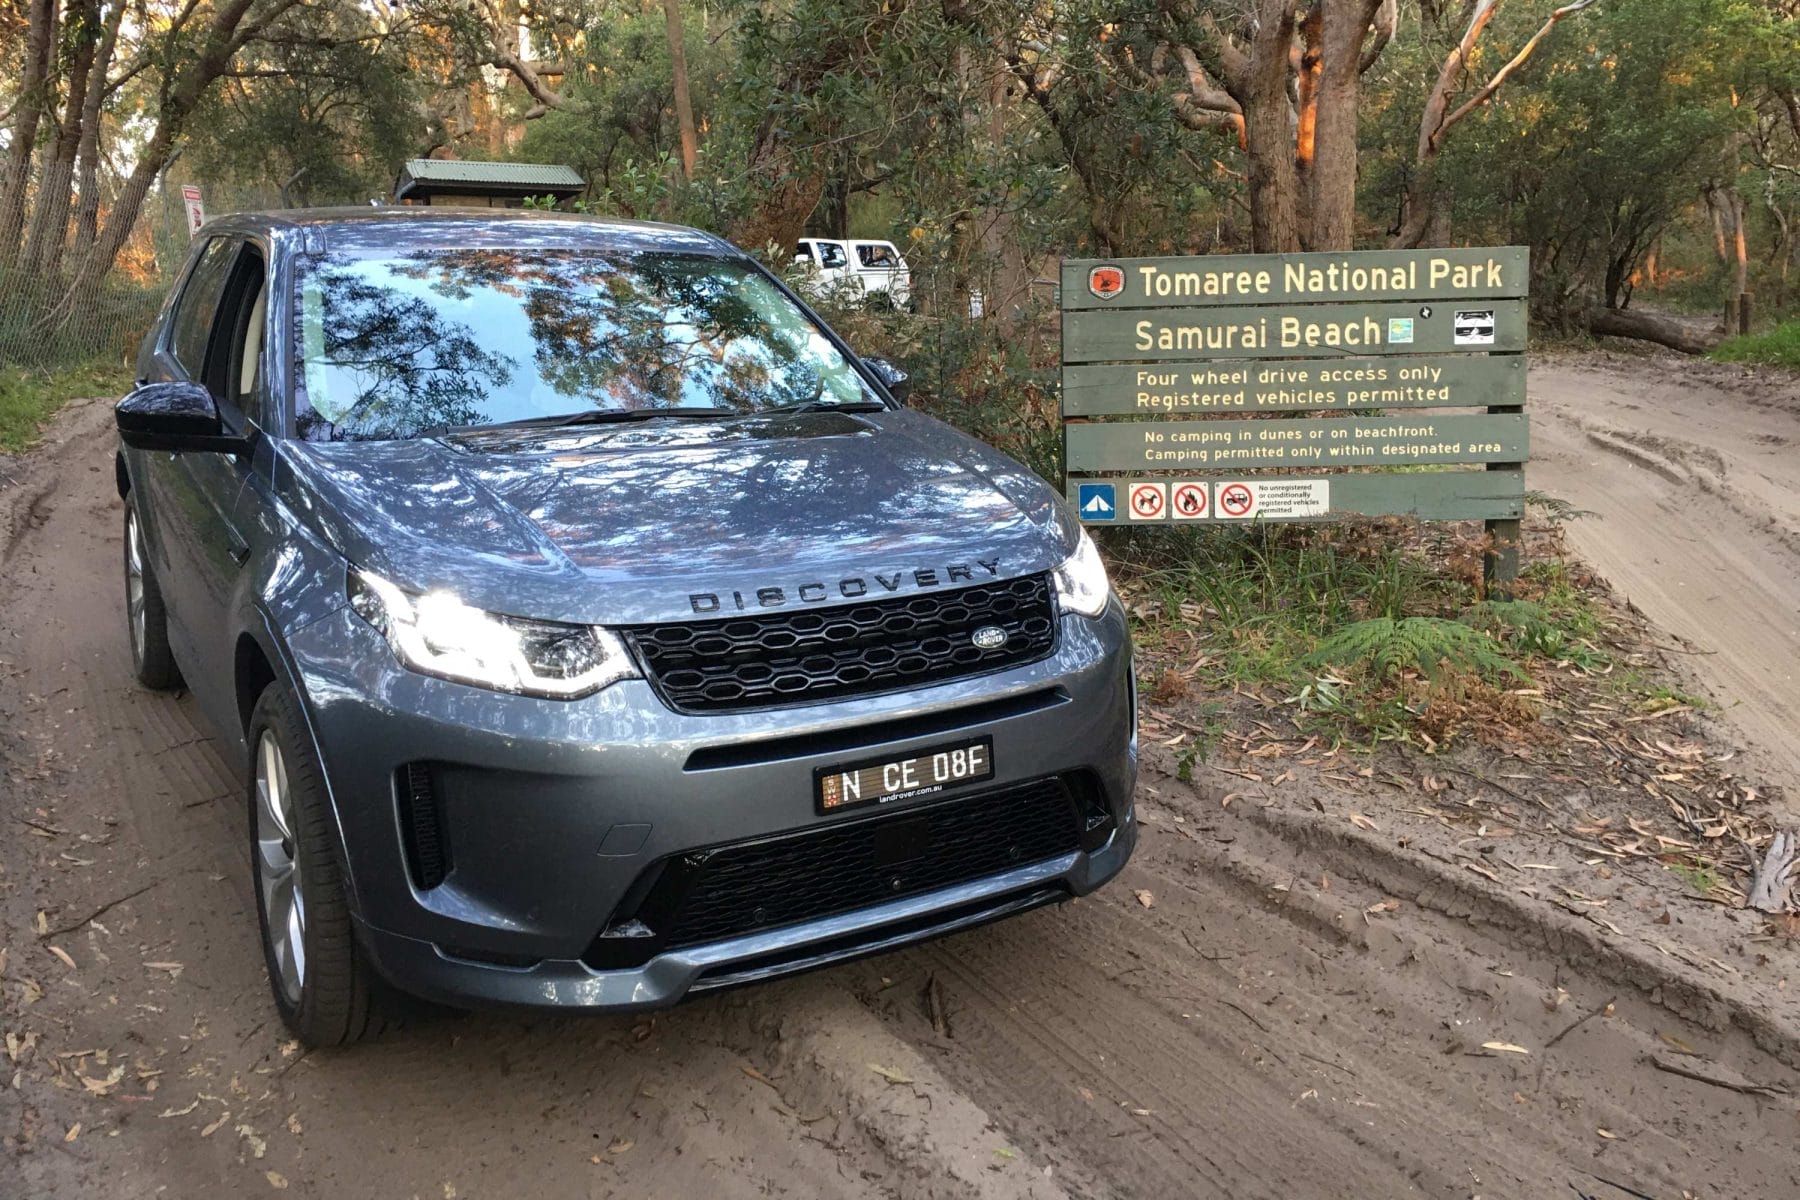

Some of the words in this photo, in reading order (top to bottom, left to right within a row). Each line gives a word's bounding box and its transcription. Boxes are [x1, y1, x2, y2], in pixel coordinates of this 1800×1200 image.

[1138, 266, 1270, 297] Tomaree
[1285, 261, 1416, 293] National
[1430, 259, 1503, 289] Park
[1135, 317, 1267, 352] Samurai
[1281, 316, 1381, 348] Beach
[1136, 371, 1179, 387] Four
[1191, 369, 1248, 385] wheel
[1258, 368, 1309, 384] drive
[1319, 367, 1388, 382] access
[1398, 365, 1442, 383] only
[1136, 390, 1246, 411] Registered
[1256, 388, 1336, 404] vehicles
[1347, 386, 1450, 407] permitted
[1145, 432, 1164, 443] No
[1170, 430, 1232, 445] camping
[1238, 429, 1252, 440] in
[1258, 427, 1303, 440] dunes
[1309, 429, 1324, 439] or
[1330, 428, 1347, 439] on
[1354, 426, 1438, 438] beachfront.
[1145, 447, 1208, 462] Camping
[1214, 446, 1284, 461] permitted
[1290, 446, 1322, 459] only
[1329, 444, 1375, 456] within
[1382, 442, 1460, 457] designated
[1468, 443, 1501, 453] area
[1267, 492, 1310, 500] conditionally
[688, 557, 1000, 614] DISCOVERY
[978, 630, 996, 639] LAND
[982, 635, 1003, 645] ROVER
[842, 770, 861, 802] N
[883, 759, 919, 792] CE
[933, 745, 984, 782] 08F
[879, 785, 942, 803] landrover.com.au
